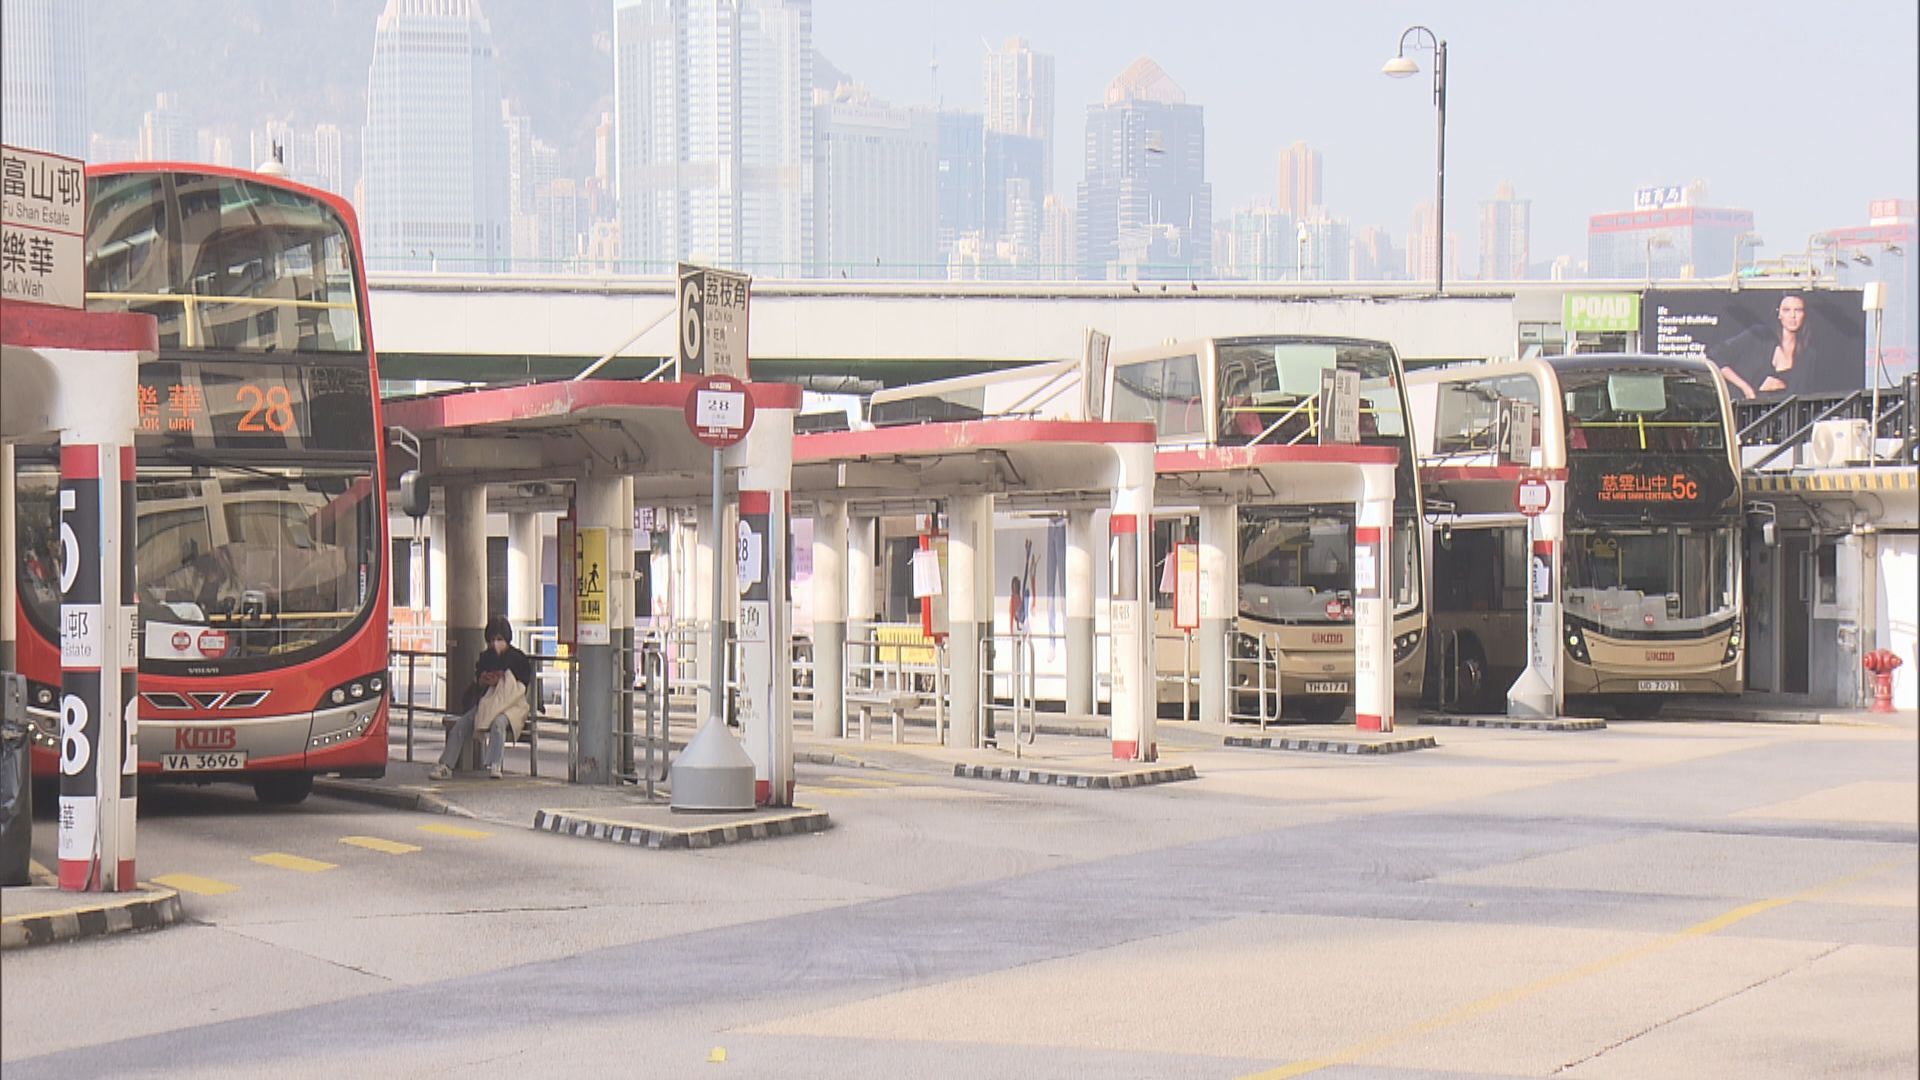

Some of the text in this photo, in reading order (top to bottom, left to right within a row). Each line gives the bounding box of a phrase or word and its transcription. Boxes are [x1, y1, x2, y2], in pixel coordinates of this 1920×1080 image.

[3, 157, 81, 207] 富山邨
[3, 200, 70, 226] Fu Shan Estate
[2, 231, 54, 277] 樂華
[2, 277, 44, 297] Lok Wah
[705, 275, 746, 311] 荔枝角
[682, 281, 701, 360] 6
[1572, 296, 1631, 319] POAD
[237, 384, 293, 432] 28
[708, 399, 729, 411] 28
[1324, 378, 1334, 429] 7
[168, 417, 196, 431] WAH
[1501, 409, 1510, 453] 2
[1601, 474, 1667, 492] 慈雲山中
[1110, 536, 1120, 595] 1
[60, 694, 90, 775] 8
[176, 727, 236, 750] KMB
[168, 752, 239, 769] VA 3696
